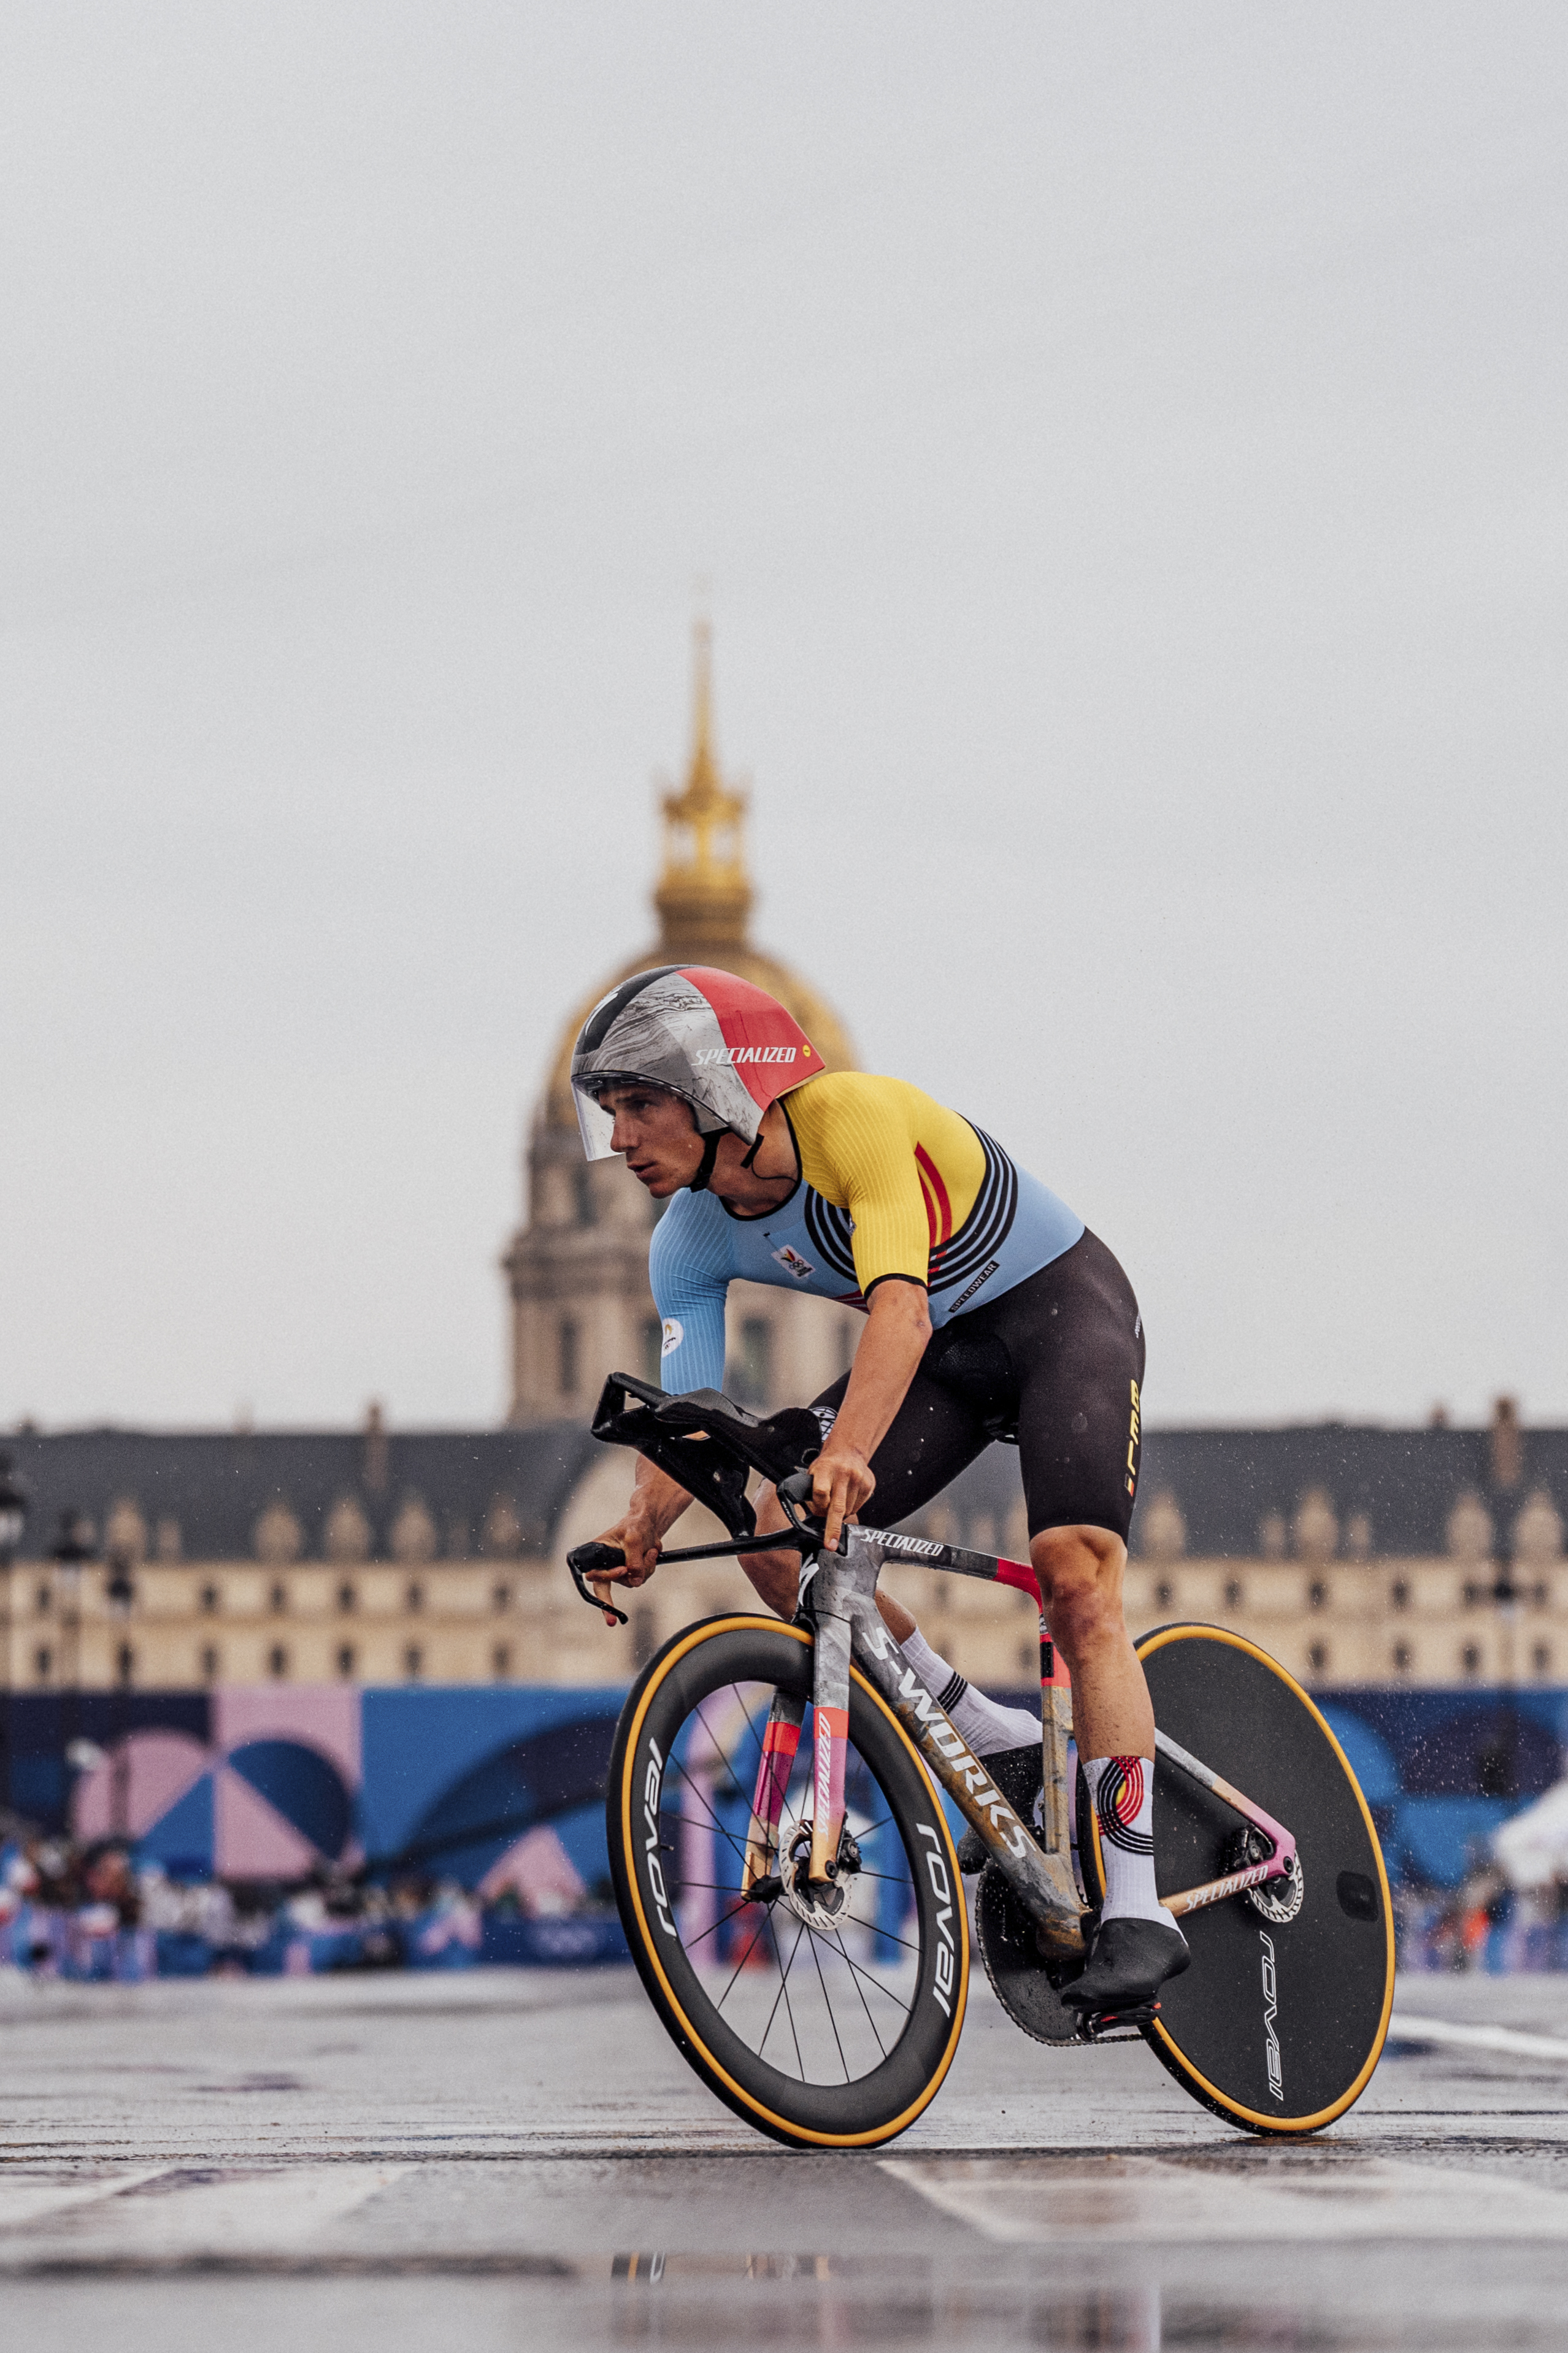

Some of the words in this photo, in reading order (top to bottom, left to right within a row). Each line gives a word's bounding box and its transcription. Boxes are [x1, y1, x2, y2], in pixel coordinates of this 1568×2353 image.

[691, 1047, 797, 1065] SPECIALIZED
[951, 1263, 997, 1311] SPEEDWEAR
[860, 1529, 944, 1557] SPECIALIZED
[862, 1627, 1037, 1859] S-WORKS
[817, 1711, 832, 1842] SPECIALIZED
[1183, 1865, 1269, 1913] SPECIALIZED
